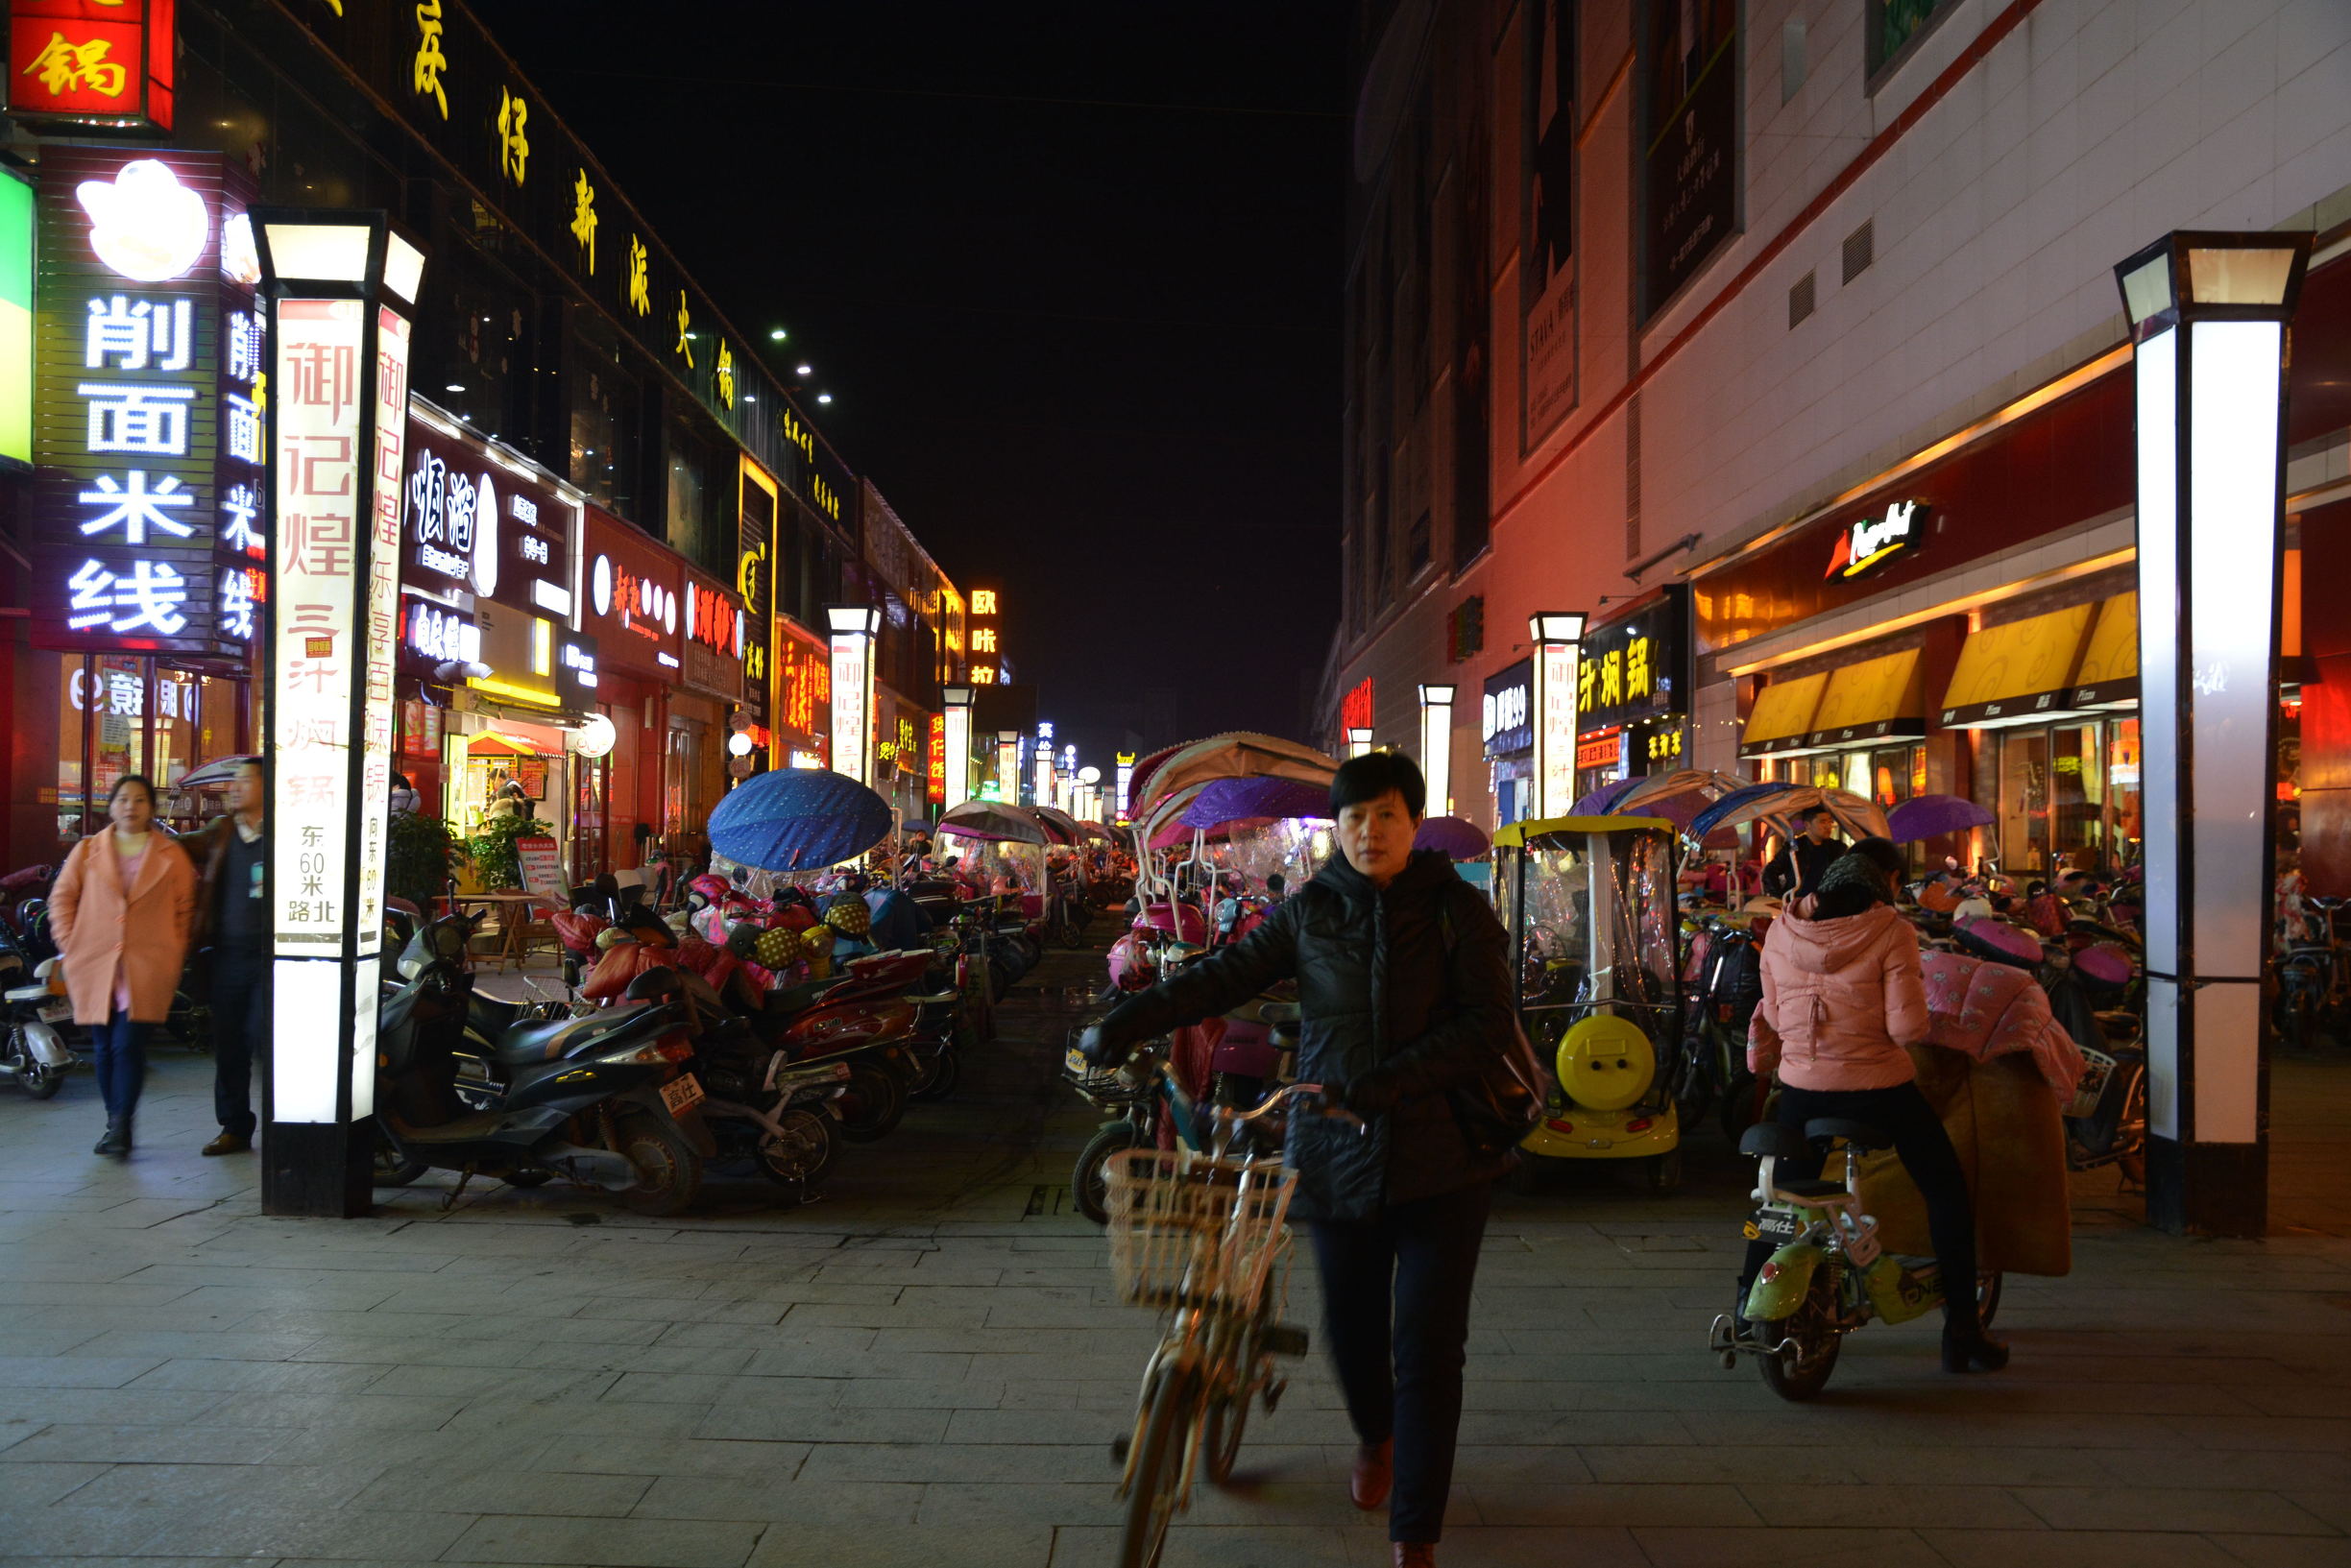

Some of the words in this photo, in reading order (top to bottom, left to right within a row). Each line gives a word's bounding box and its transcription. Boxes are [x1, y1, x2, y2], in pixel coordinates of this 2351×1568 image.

[24, 32, 126, 97] 锅
[69, 296, 195, 635] 削面米线
[224, 312, 259, 639] 削面米线
[1579, 637, 1648, 712] 汁焖锅
